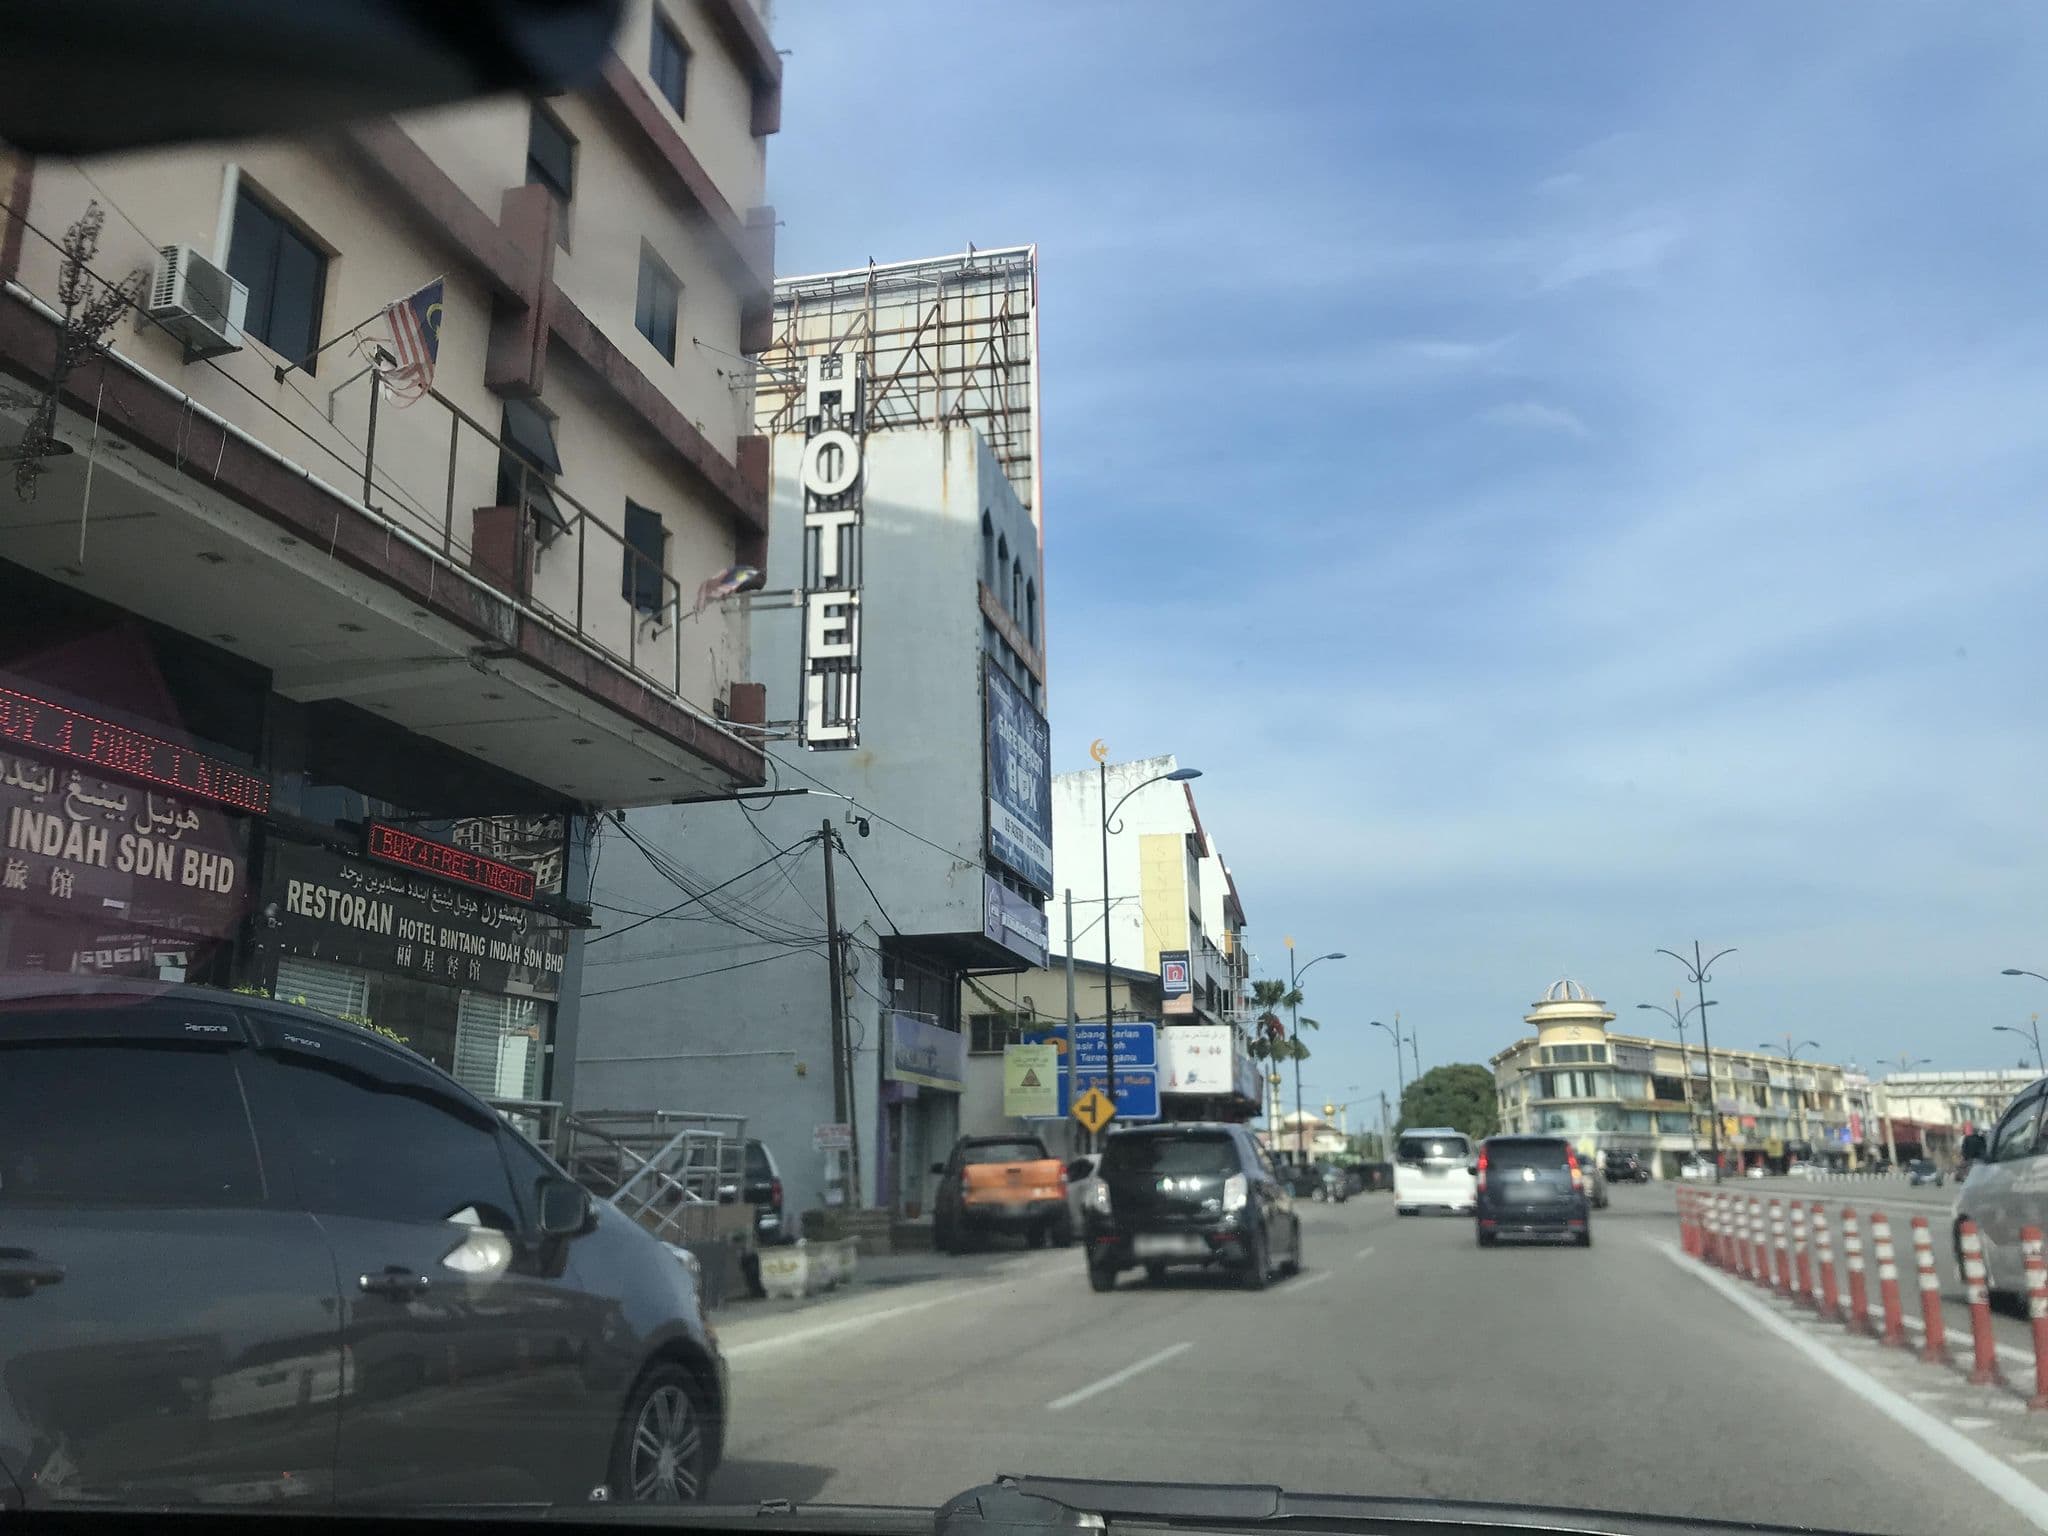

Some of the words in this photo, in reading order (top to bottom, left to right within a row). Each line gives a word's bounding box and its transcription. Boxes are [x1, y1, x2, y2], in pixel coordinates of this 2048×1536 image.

[803, 352, 862, 741] HOTEL
[8, 805, 109, 869] INDAH
[117, 833, 176, 882] SDN
[182, 848, 234, 894] BHD
[383, 831, 417, 862] BUY
[432, 848, 471, 878] FREE
[484, 863, 527, 894] NIGHT
[286, 878, 394, 935] RESTORAN
[398, 917, 437, 947] HOTEL
[440, 928, 486, 957] BINTANG
[489, 939, 520, 965] INDAH
[523, 947, 543, 969] SDN
[545, 951, 564, 974] BHD
[184, 1022, 229, 1032] Persona
[284, 1033, 322, 1048] Persona
[1075, 1030, 1105, 1040] ubang
[1080, 1053, 1137, 1063] Terenganu
